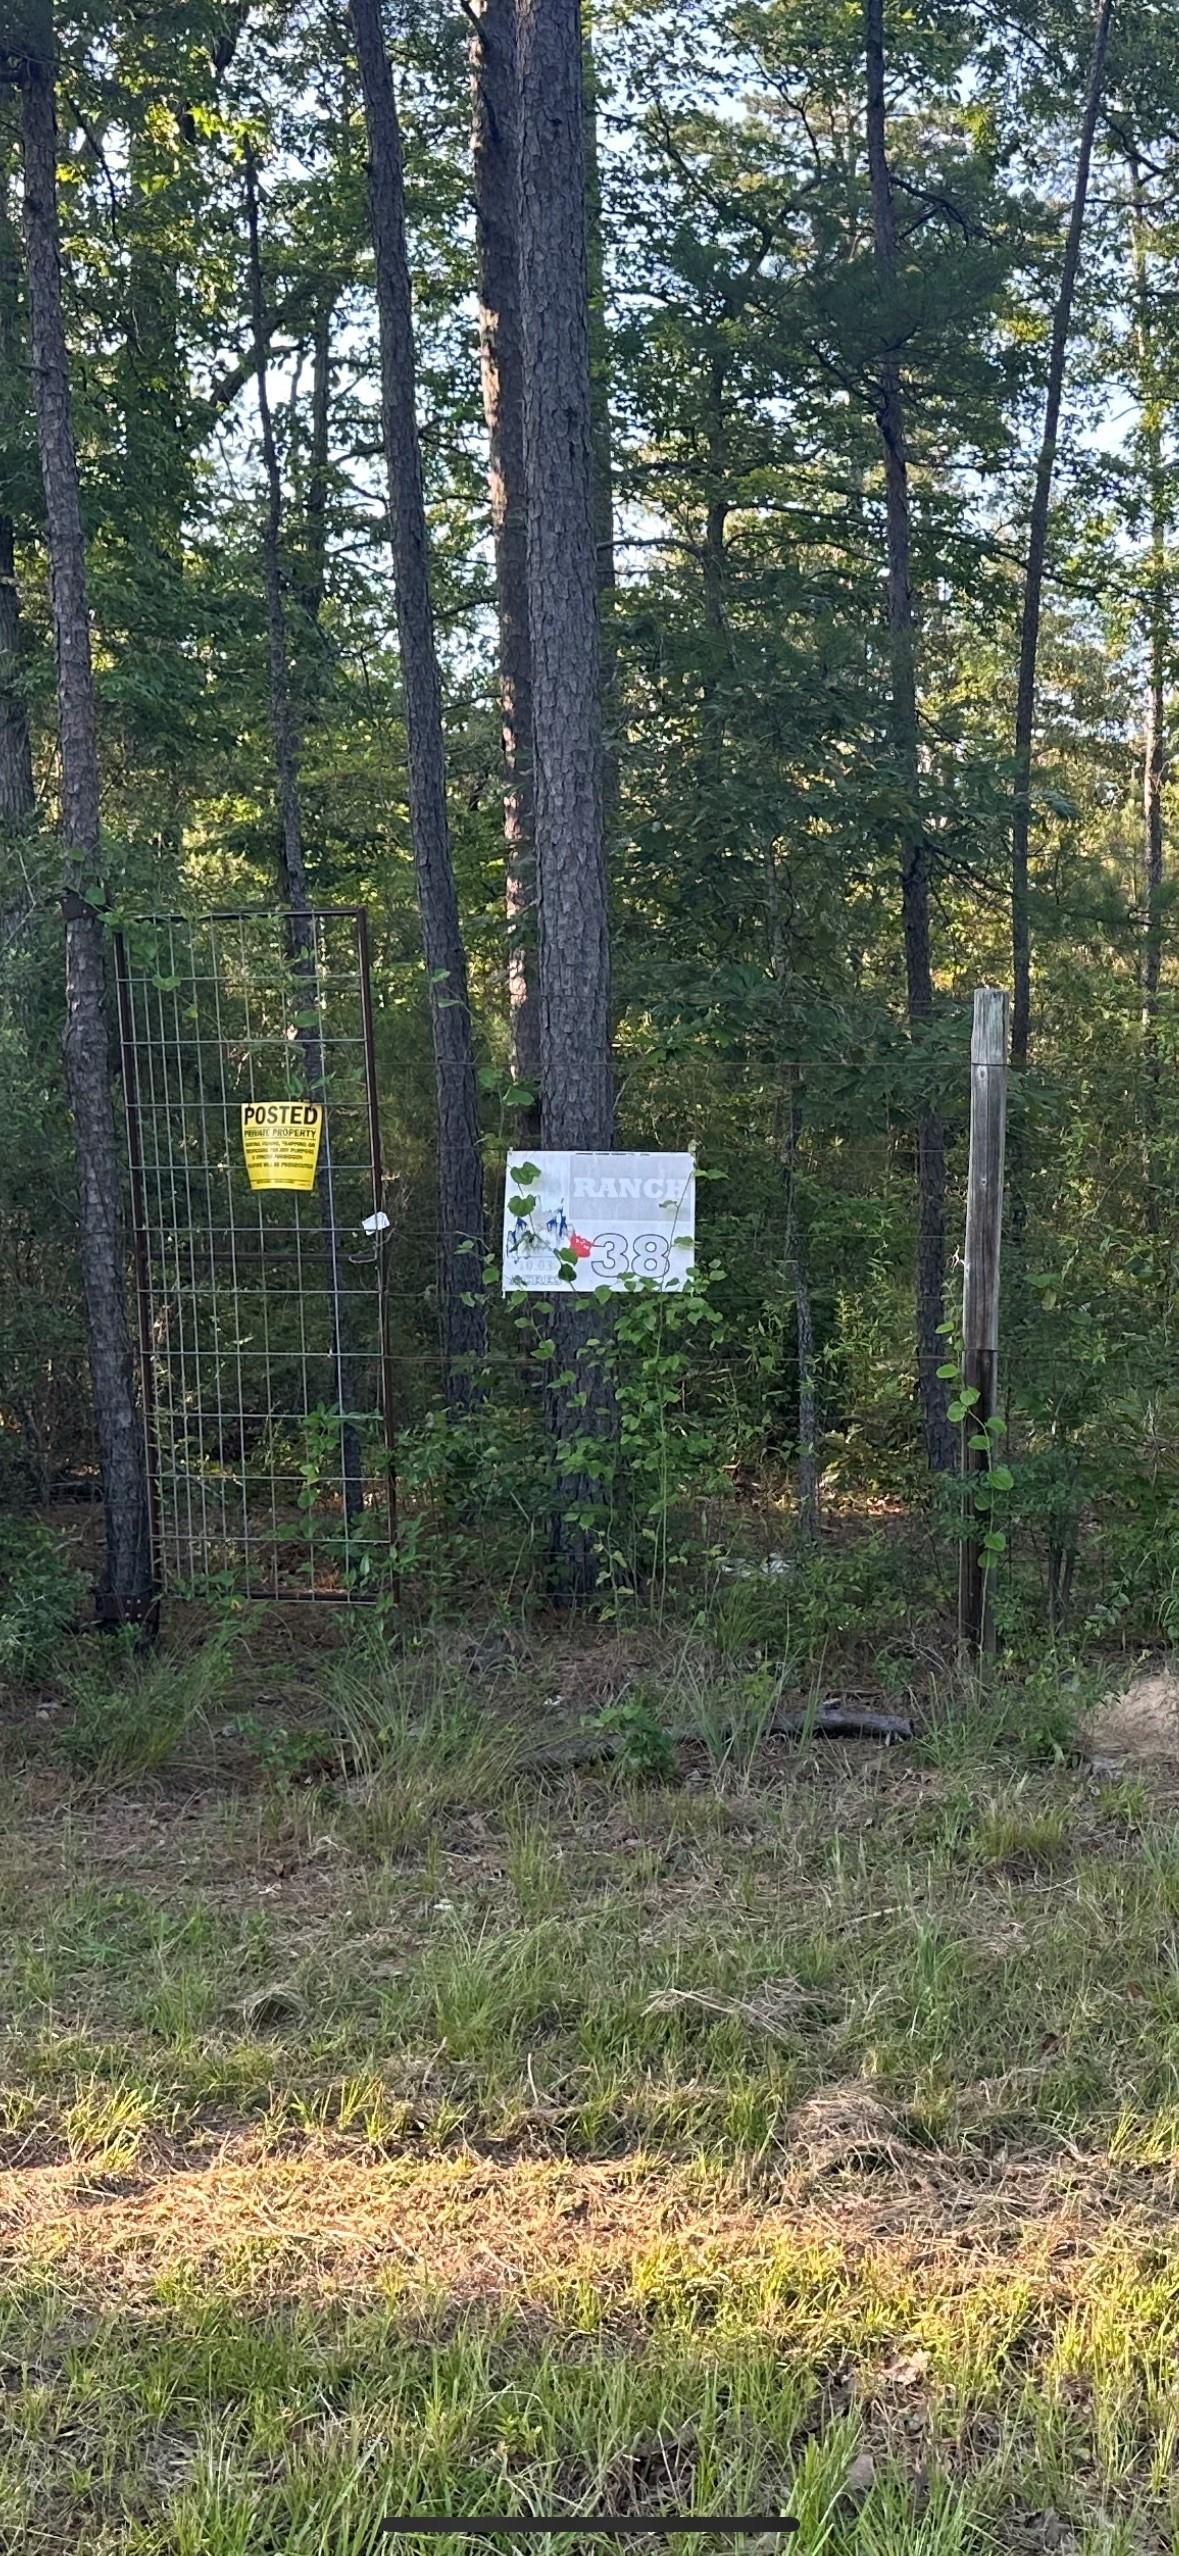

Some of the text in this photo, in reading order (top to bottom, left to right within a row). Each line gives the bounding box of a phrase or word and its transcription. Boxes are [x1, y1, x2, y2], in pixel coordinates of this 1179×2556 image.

[245, 1105, 318, 1126] POSTED
[272, 1128, 316, 1138] PROPERTY
[574, 1177, 689, 1199] RANCH
[591, 1232, 671, 1279] 38
